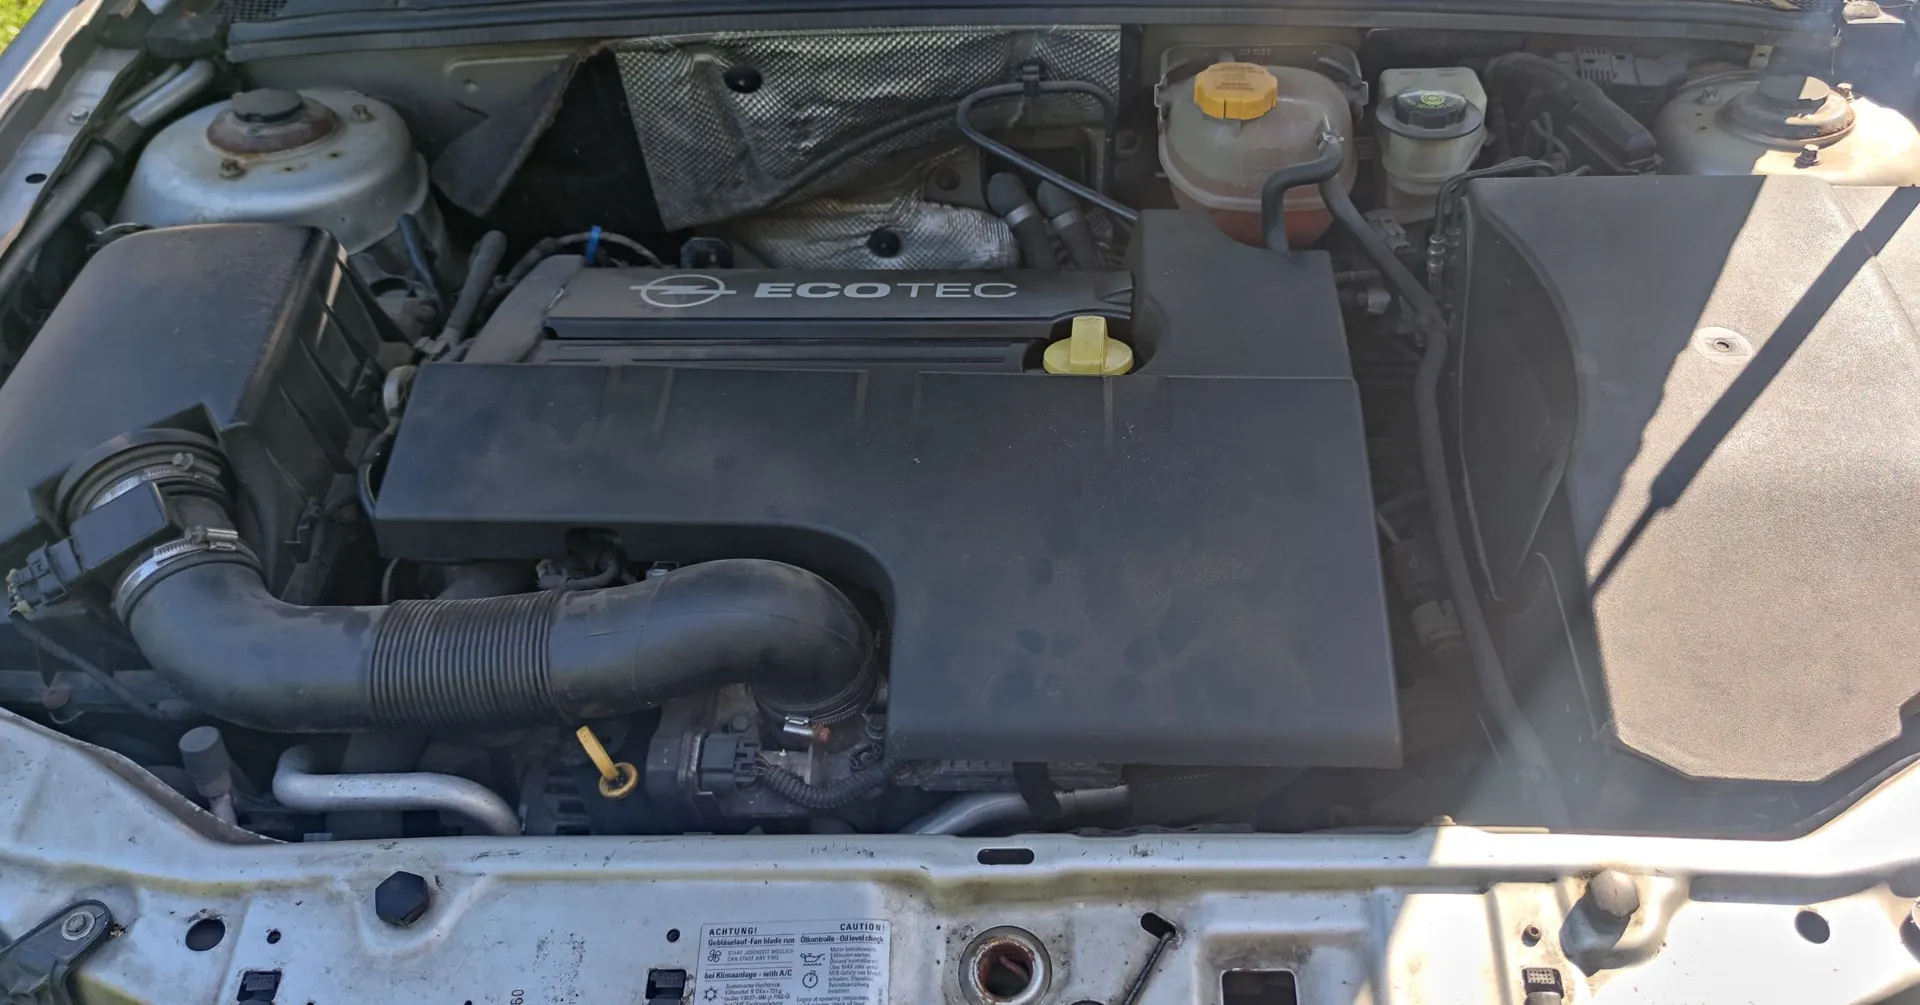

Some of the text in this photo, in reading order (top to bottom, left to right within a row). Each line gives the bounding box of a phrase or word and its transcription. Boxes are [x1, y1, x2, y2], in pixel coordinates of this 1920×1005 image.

[754, 283, 1017, 298] ECOTEC
[840, 923, 884, 931] CAUTION!
[709, 927, 757, 936] ACHTUNG!
[849, 934, 864, 942] level
[716, 971, 757, 979] Klimaanlage
